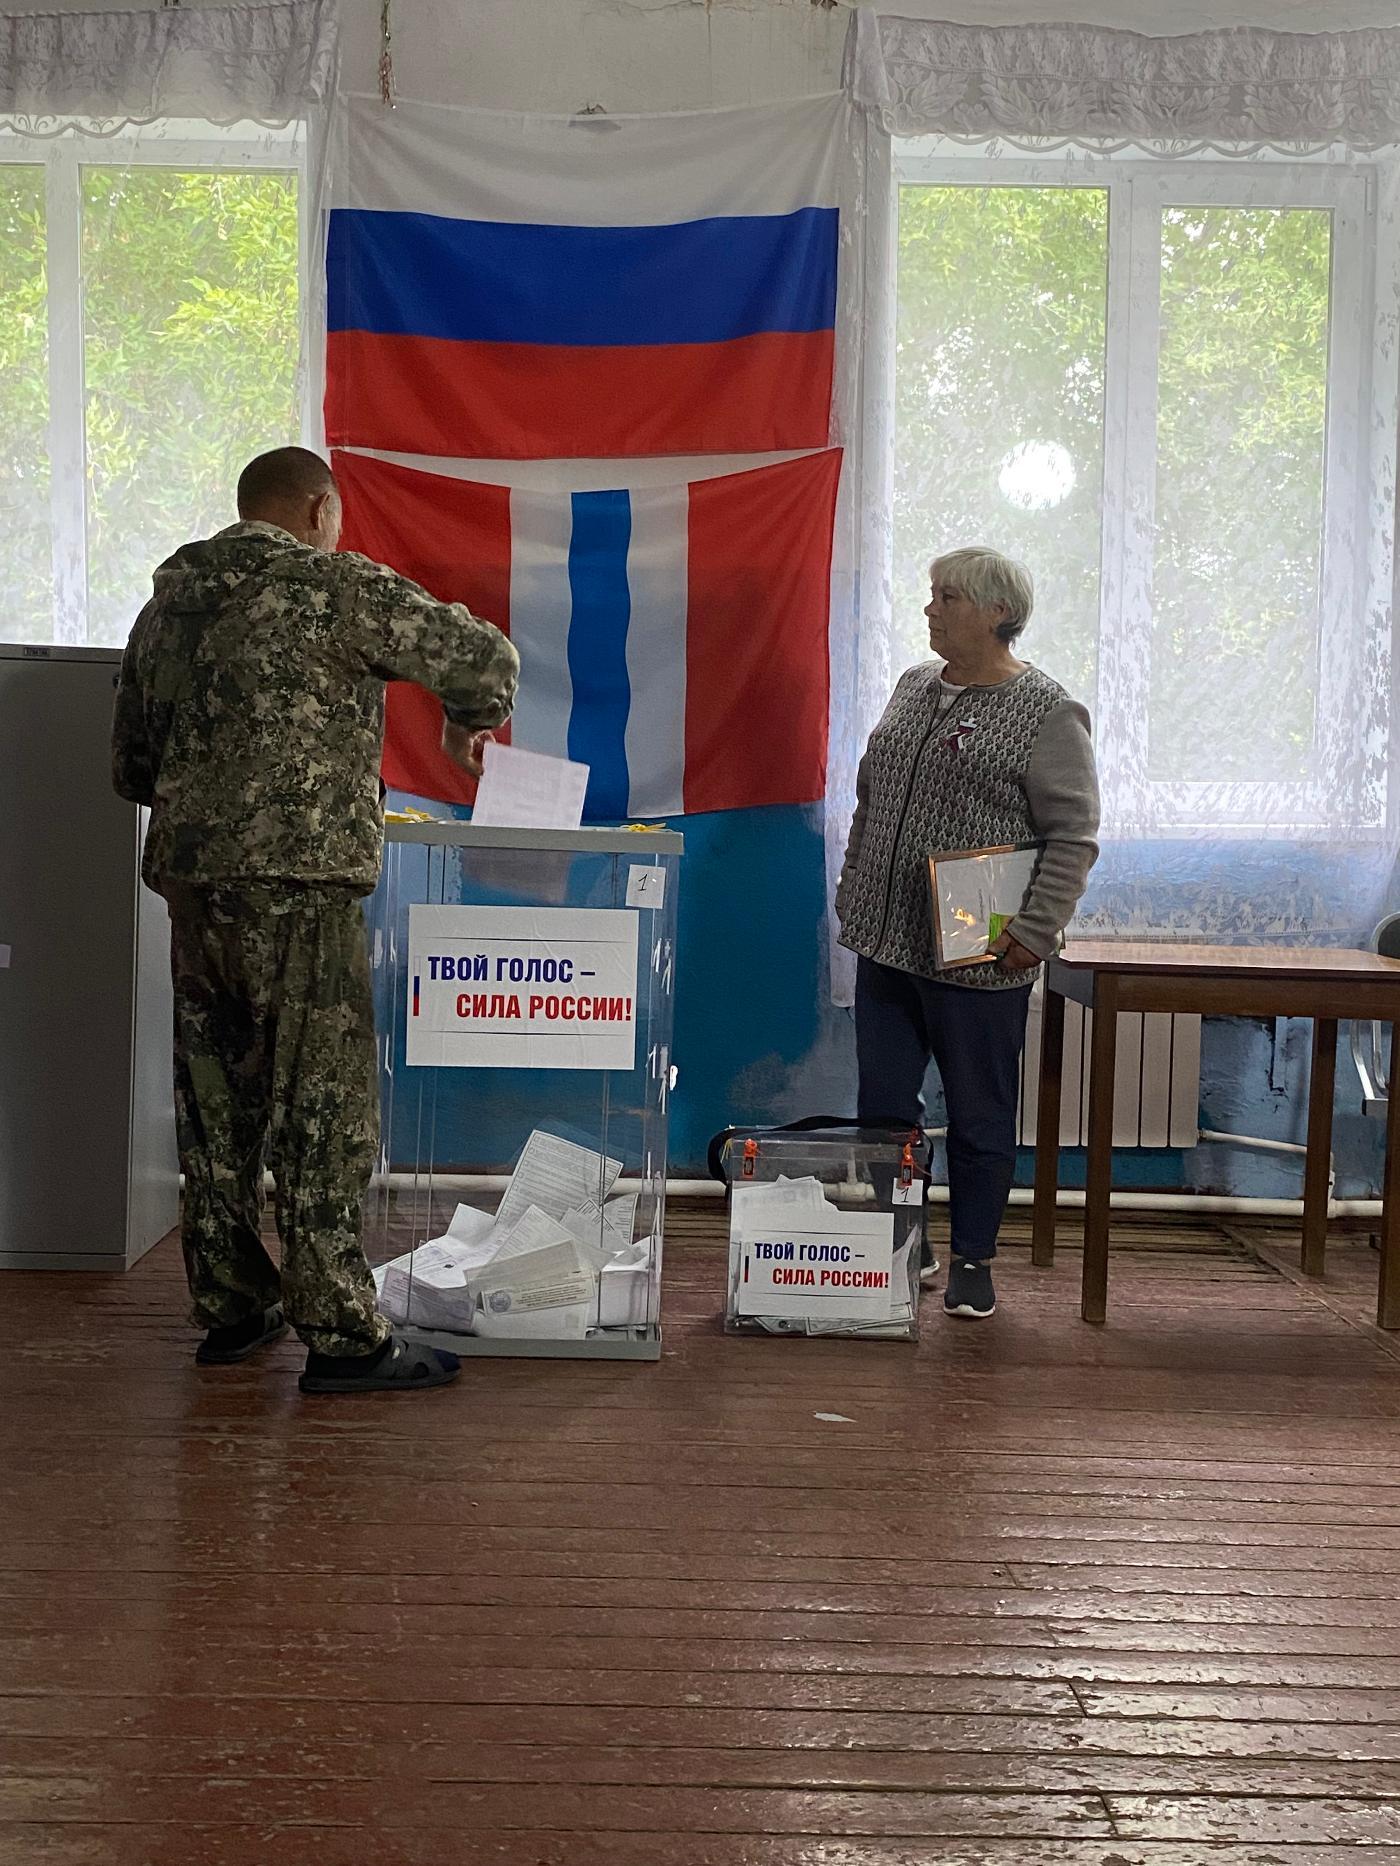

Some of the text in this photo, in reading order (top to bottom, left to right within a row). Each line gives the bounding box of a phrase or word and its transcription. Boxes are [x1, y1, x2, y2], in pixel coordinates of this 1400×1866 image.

[638, 873, 648, 891] 1
[428, 954, 488, 982] ТВОЙ
[496, 957, 574, 984] ГОЛОС
[456, 993, 632, 1020] СИЛА РОССИИ!
[755, 1242, 794, 1260] ТВОЙ
[799, 1244, 851, 1263] ГОЛОС
[772, 1268, 890, 1289] СИЛА РОССИИ!
